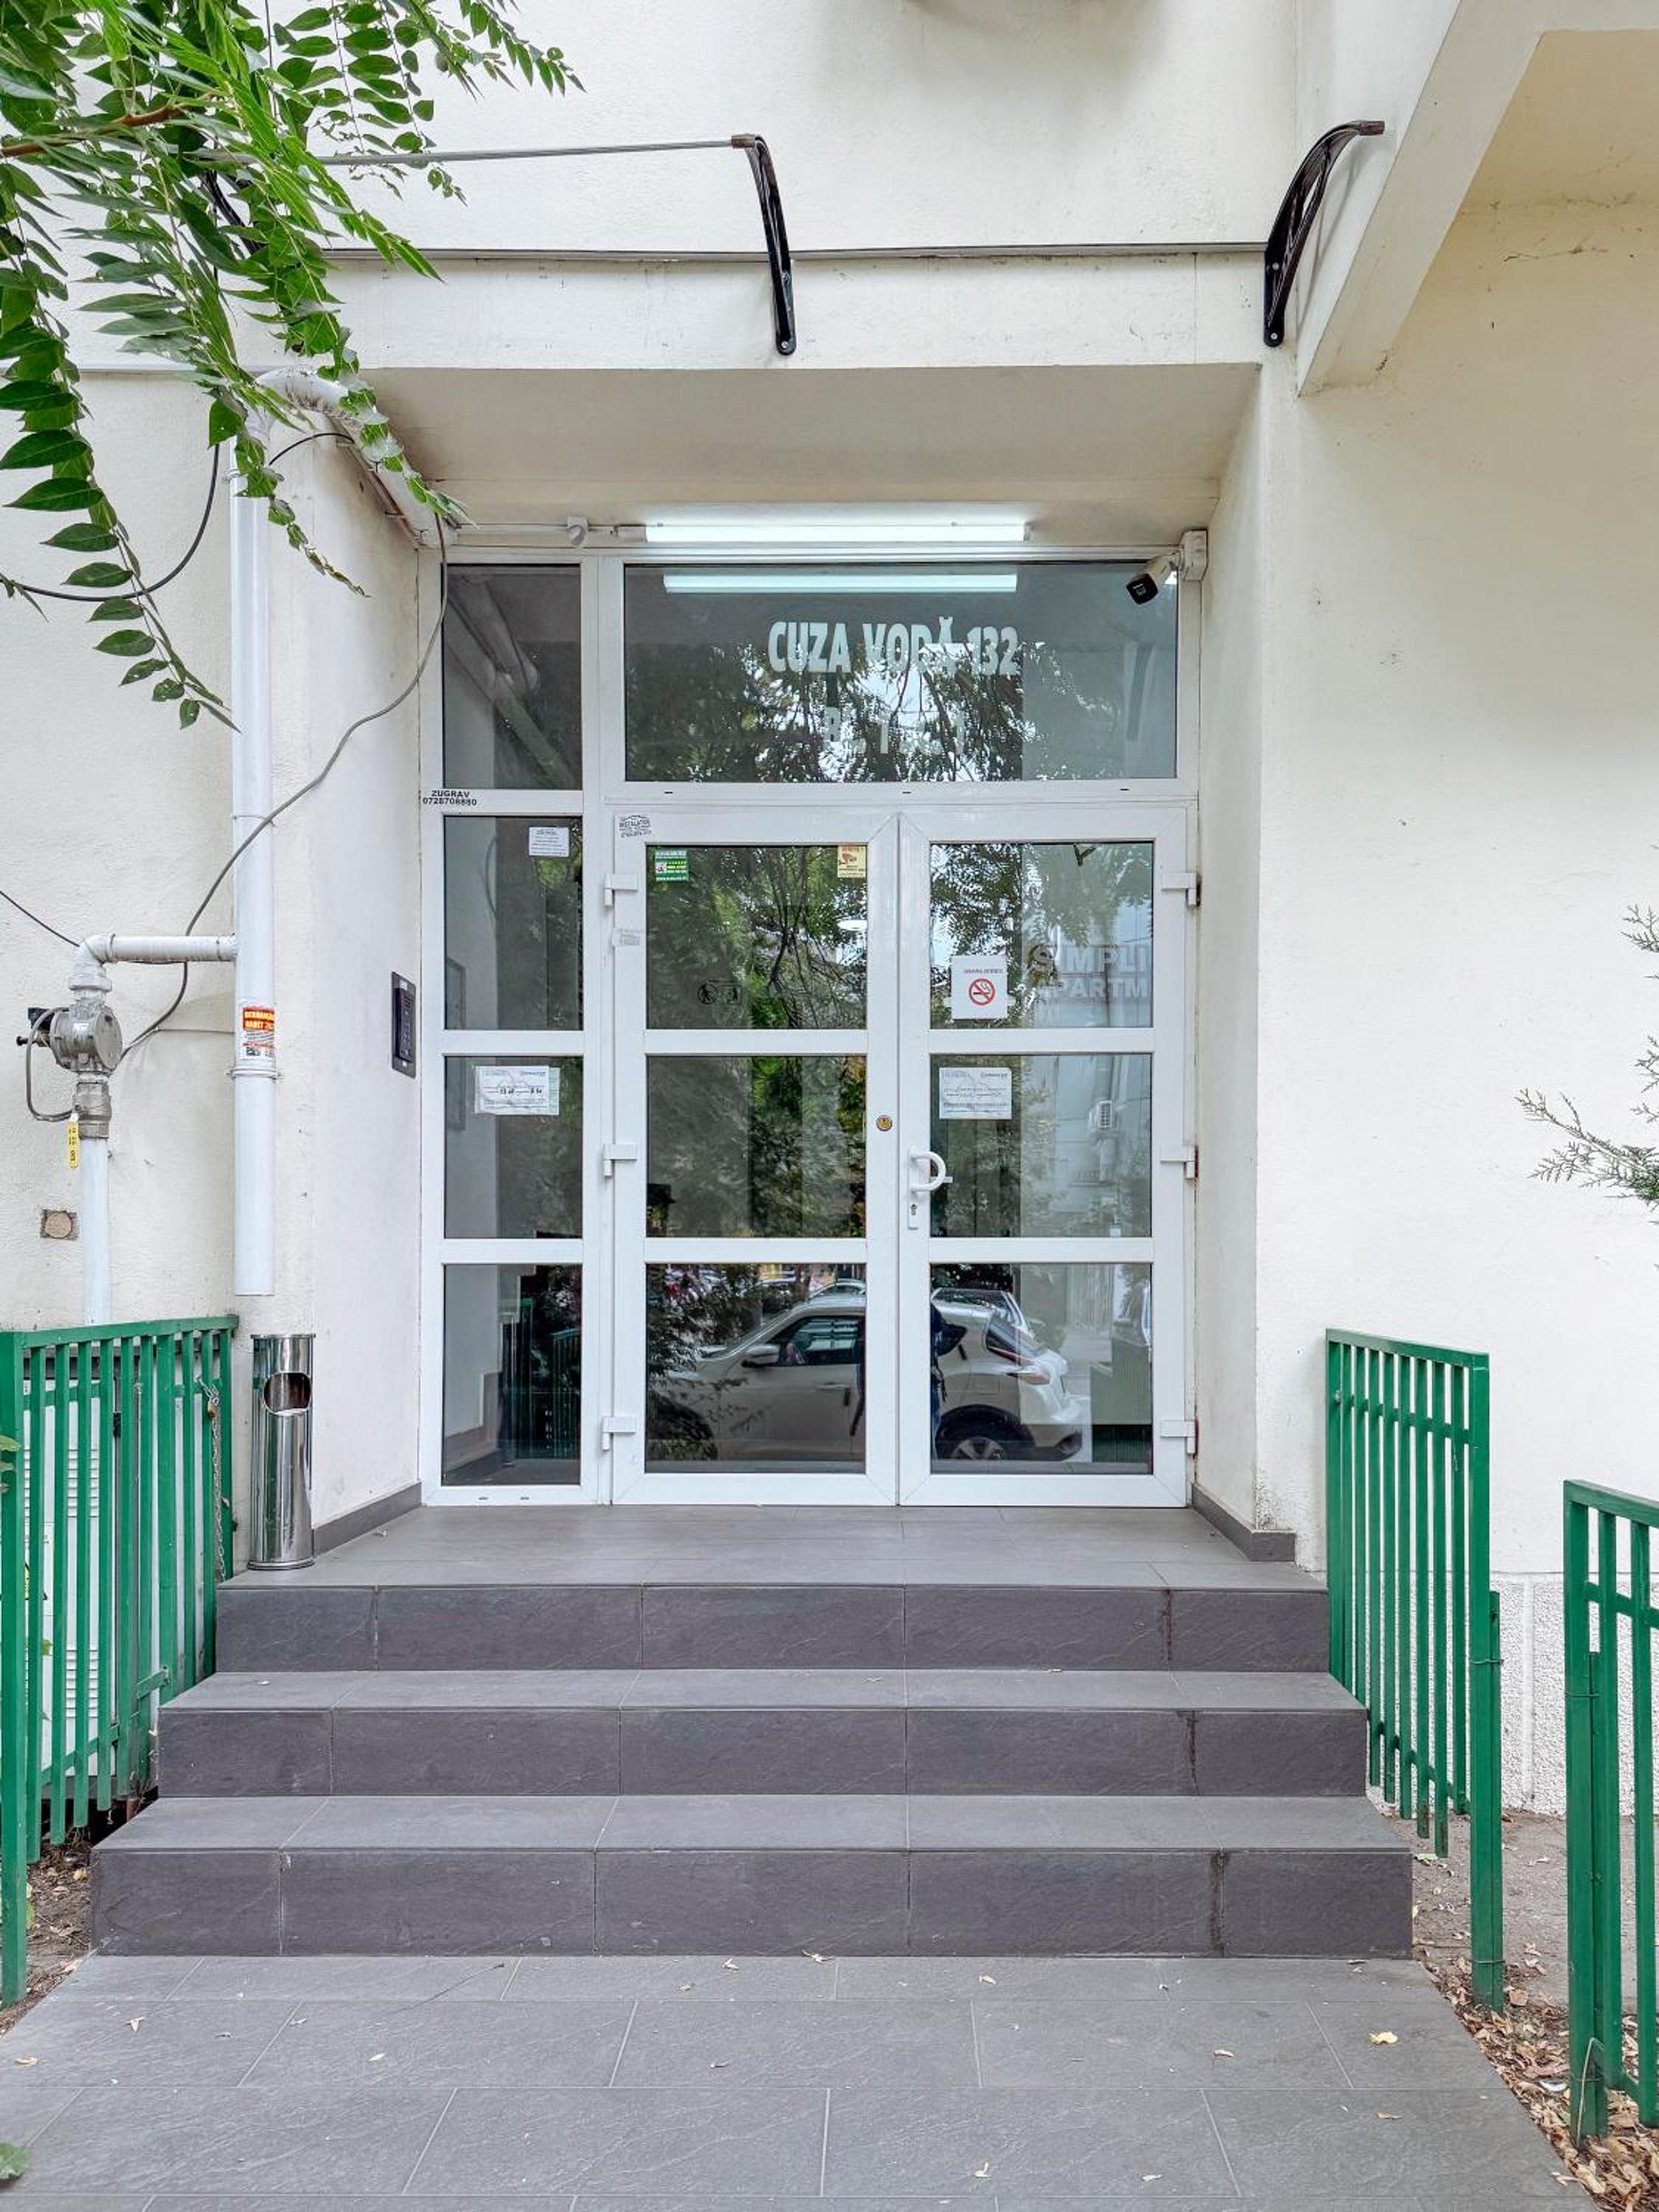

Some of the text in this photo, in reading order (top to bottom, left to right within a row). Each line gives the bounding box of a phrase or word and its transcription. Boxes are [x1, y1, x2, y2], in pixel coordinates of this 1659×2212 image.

[768, 622, 851, 672] CUZA
[967, 627, 1018, 676] 132
[431, 790, 470, 798] ZUGRAV
